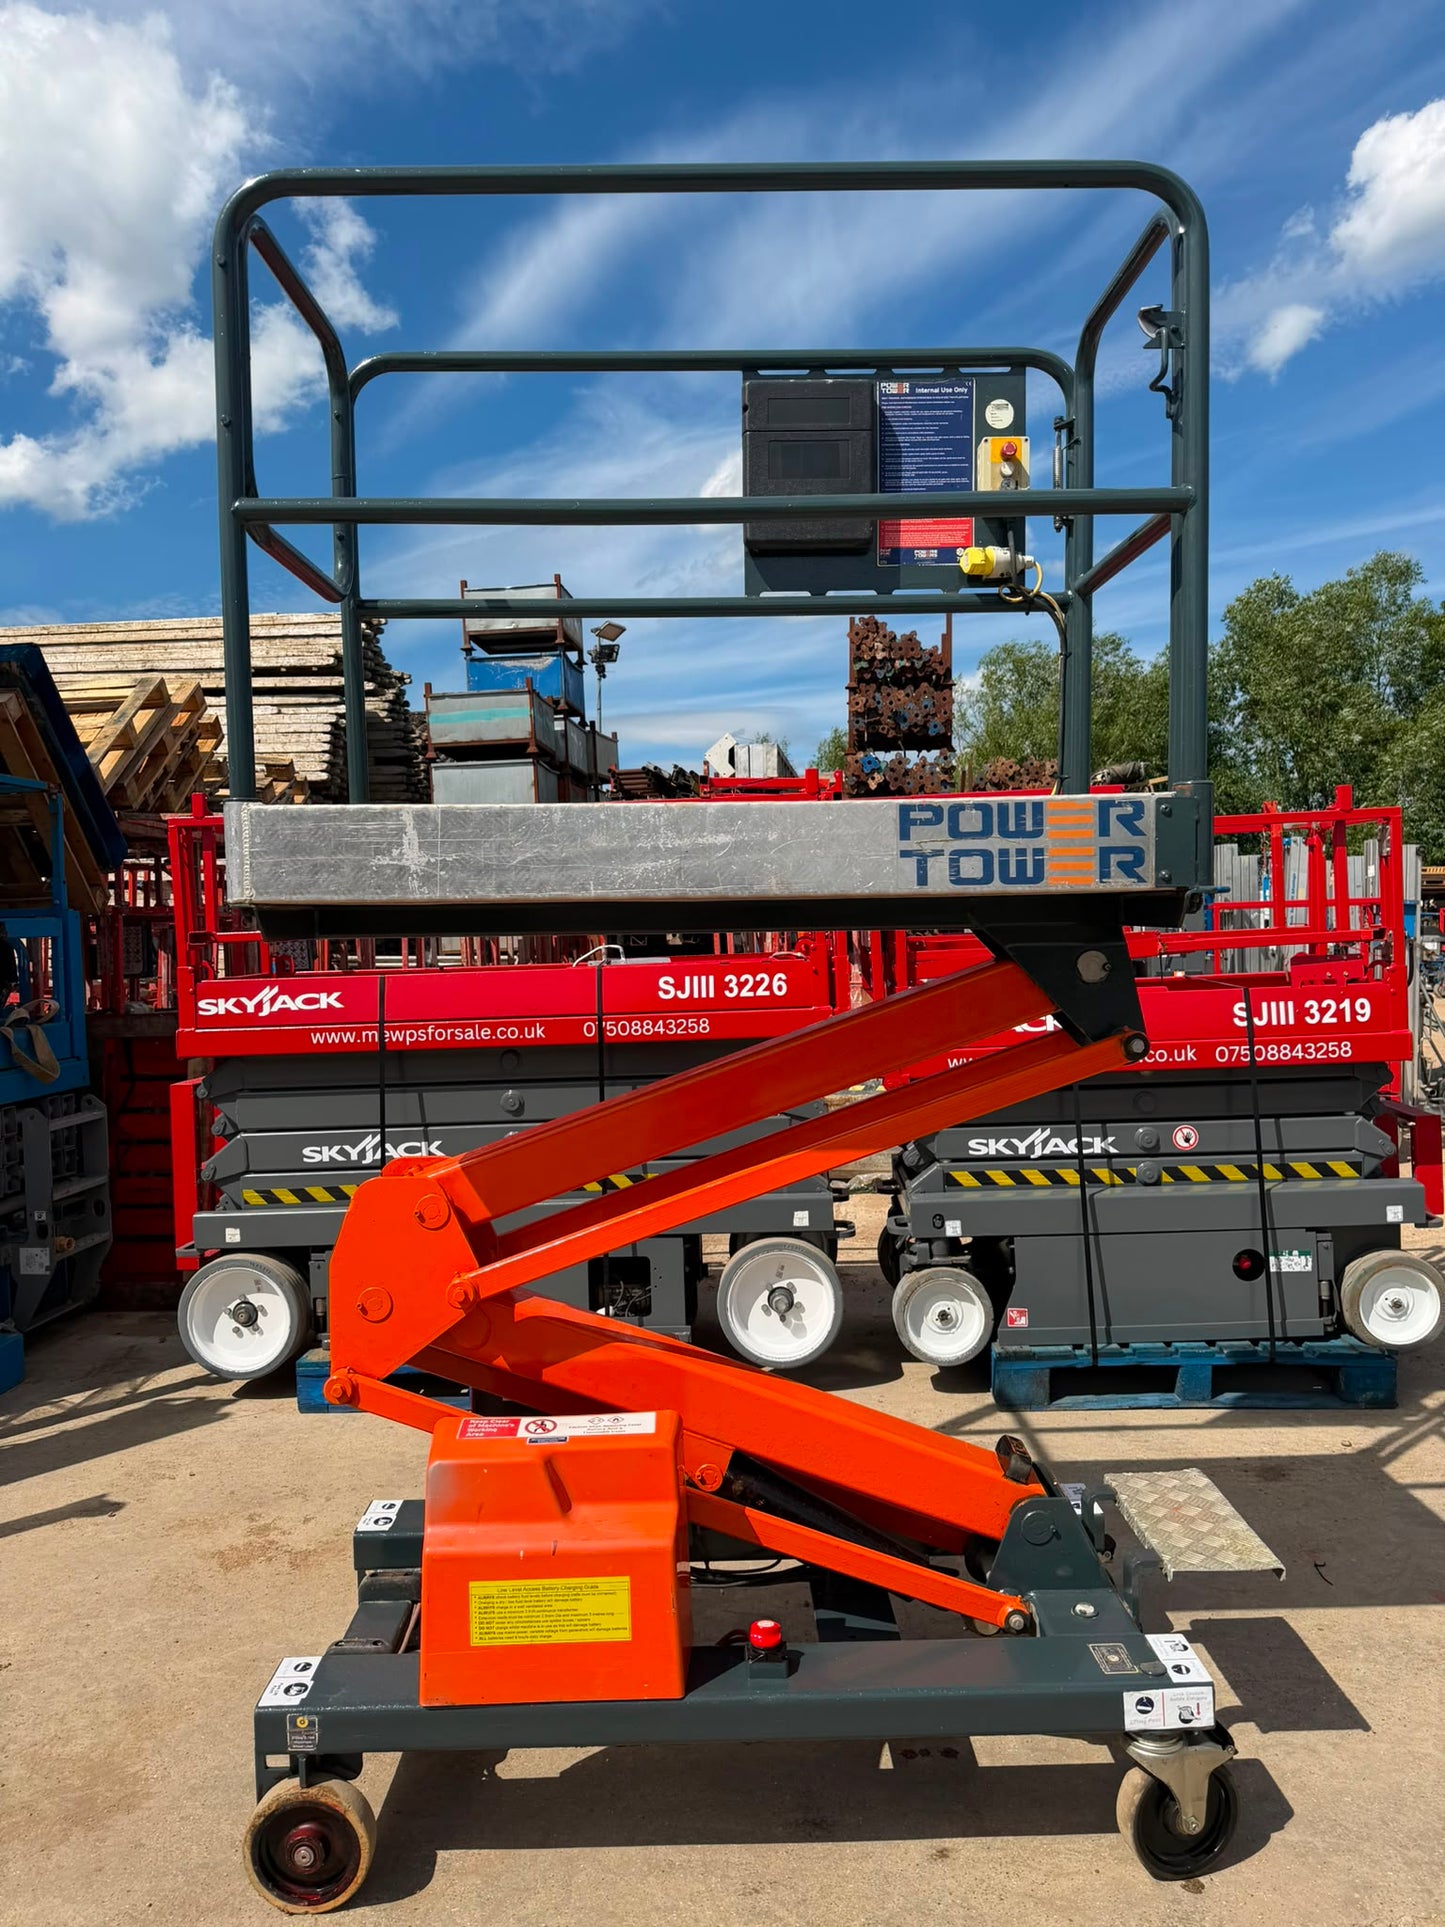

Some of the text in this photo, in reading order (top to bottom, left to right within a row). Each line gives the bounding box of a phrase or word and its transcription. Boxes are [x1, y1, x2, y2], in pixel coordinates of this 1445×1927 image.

[953, 386, 968, 394] Only
[899, 800, 1147, 841] POWER
[899, 846, 1147, 886] TOWER
[198, 985, 344, 1017] SKYJACK
[657, 973, 788, 999] SJIII 3226
[1232, 998, 1371, 1027] SJIII 3219
[1215, 1041, 1352, 1063] 07508843258
[302, 1133, 446, 1164] SKYJACK
[968, 1127, 1120, 1159] SKYJACK
